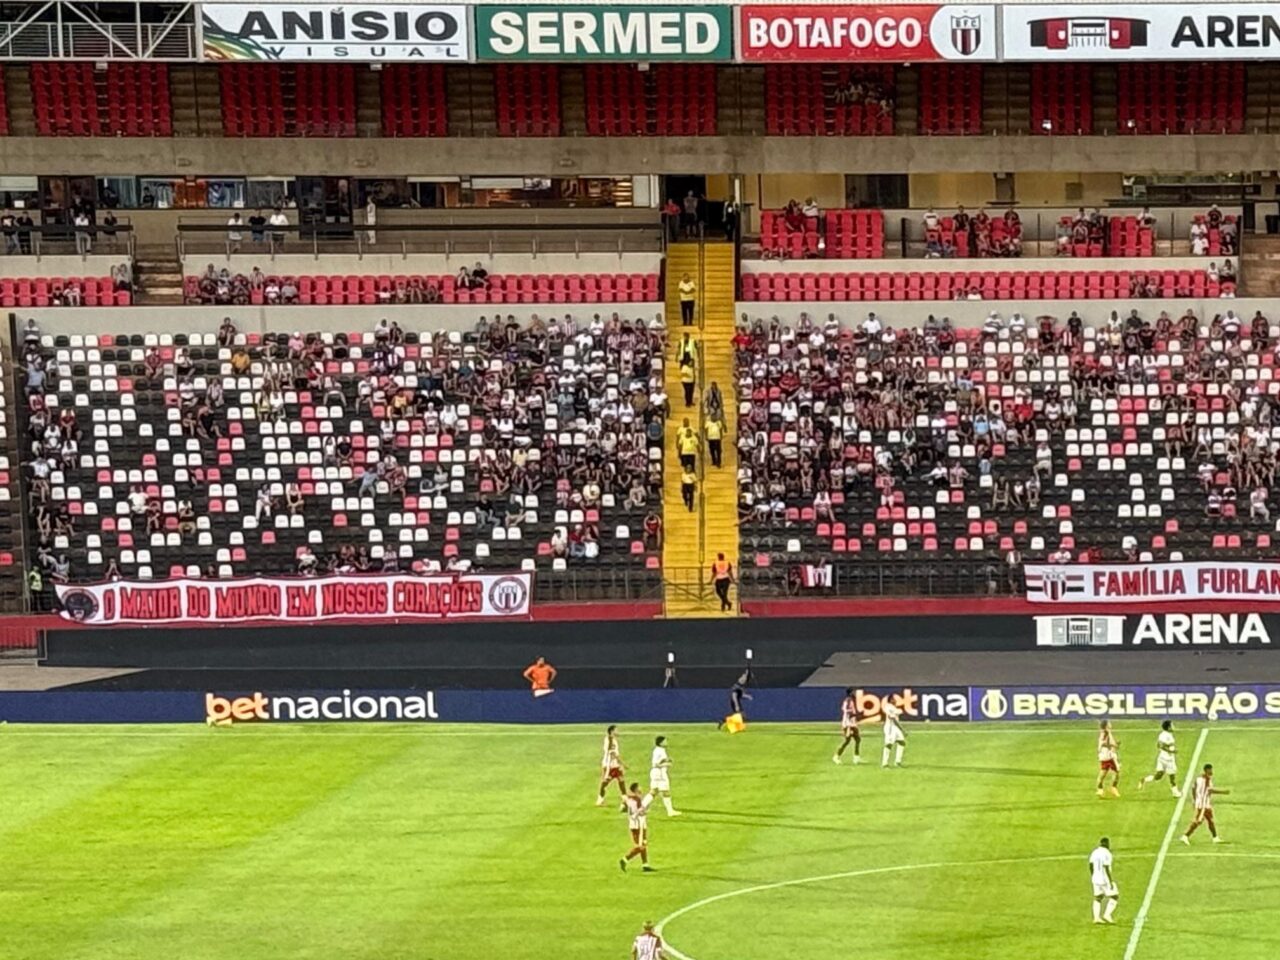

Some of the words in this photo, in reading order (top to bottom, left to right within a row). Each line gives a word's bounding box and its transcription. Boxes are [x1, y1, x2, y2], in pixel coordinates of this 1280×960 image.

[239, 7, 458, 41] ANÍSIO
[489, 11, 720, 54] SERMED
[749, 17, 922, 48] BOTAFOGO
[270, 46, 459, 57] VISUAL
[1093, 567, 1186, 596] FAMÍLIA
[103, 589, 115, 620] O
[120, 586, 181, 620] MAIOR
[186, 586, 210, 618] DO
[215, 584, 281, 618] MUNDO
[286, 585, 317, 618] EM
[322, 582, 388, 616] NOSSOS
[1132, 614, 1270, 645] ARENA
[205, 689, 439, 720] betnacional
[1013, 686, 1258, 715] BRASILEIRÃO
